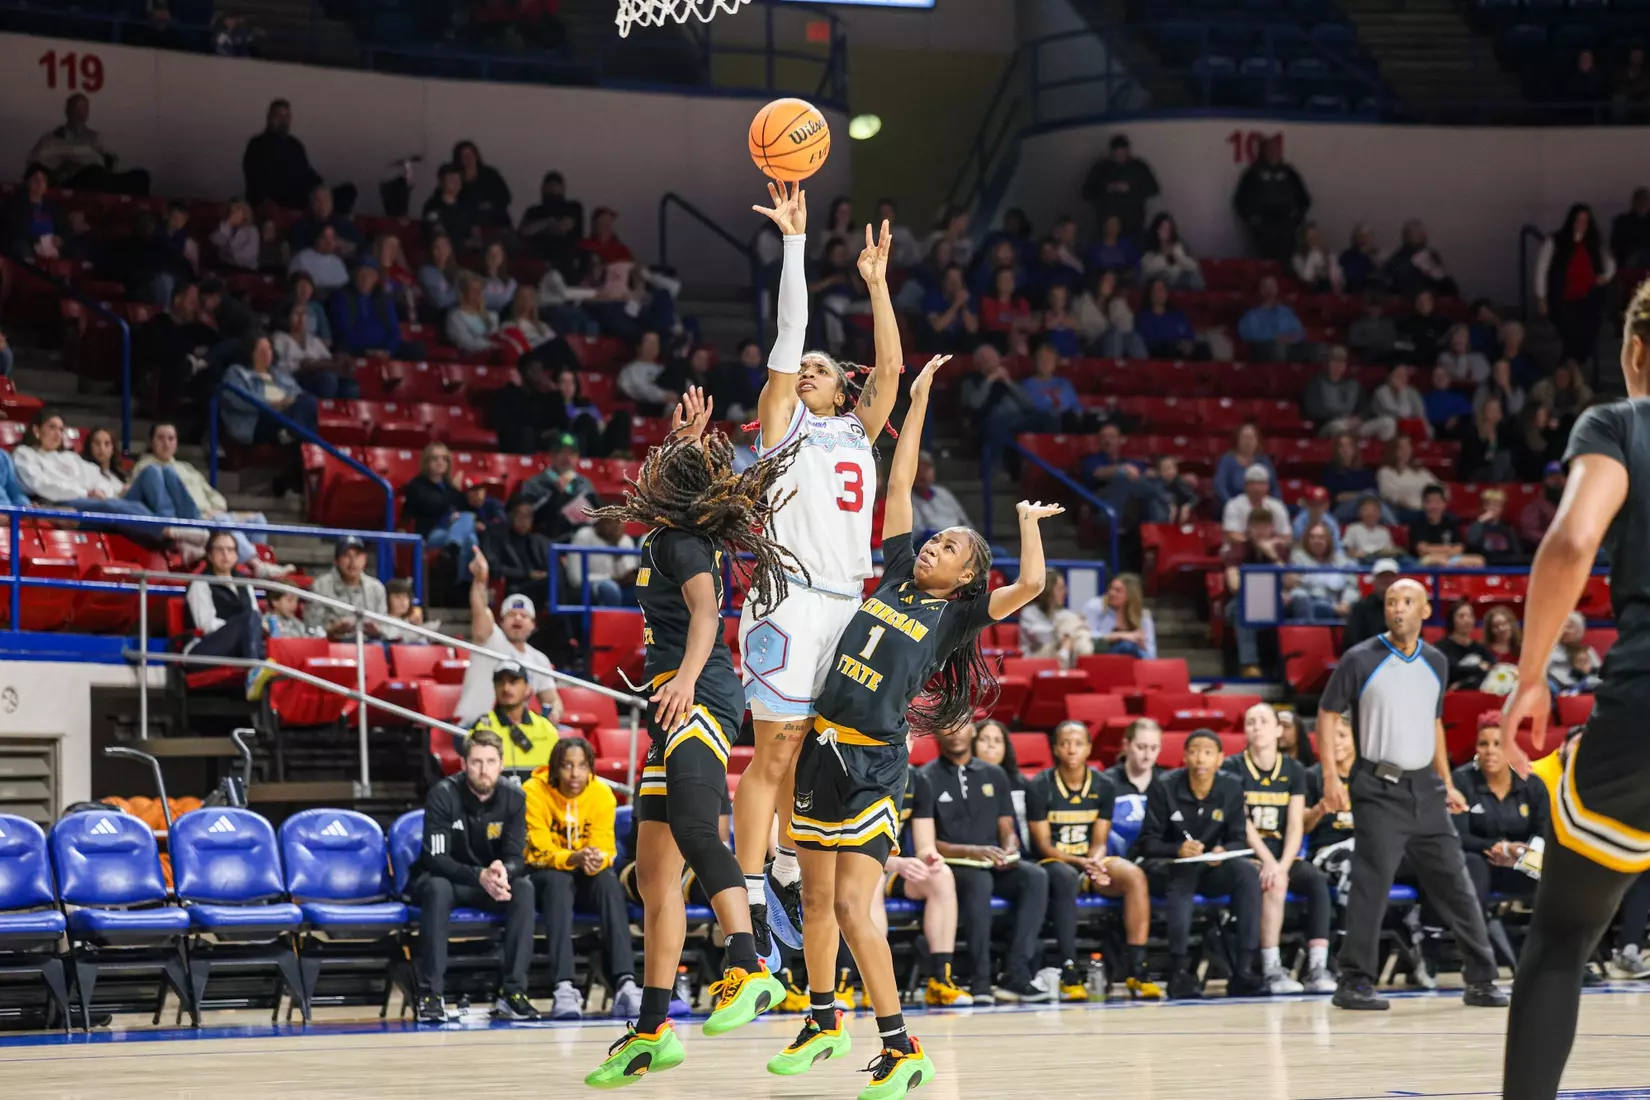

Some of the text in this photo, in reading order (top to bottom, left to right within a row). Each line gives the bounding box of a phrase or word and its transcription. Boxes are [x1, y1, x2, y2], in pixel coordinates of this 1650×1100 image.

[39, 48, 104, 93] 119
[835, 461, 864, 513] 3
[859, 624, 887, 661] 1
